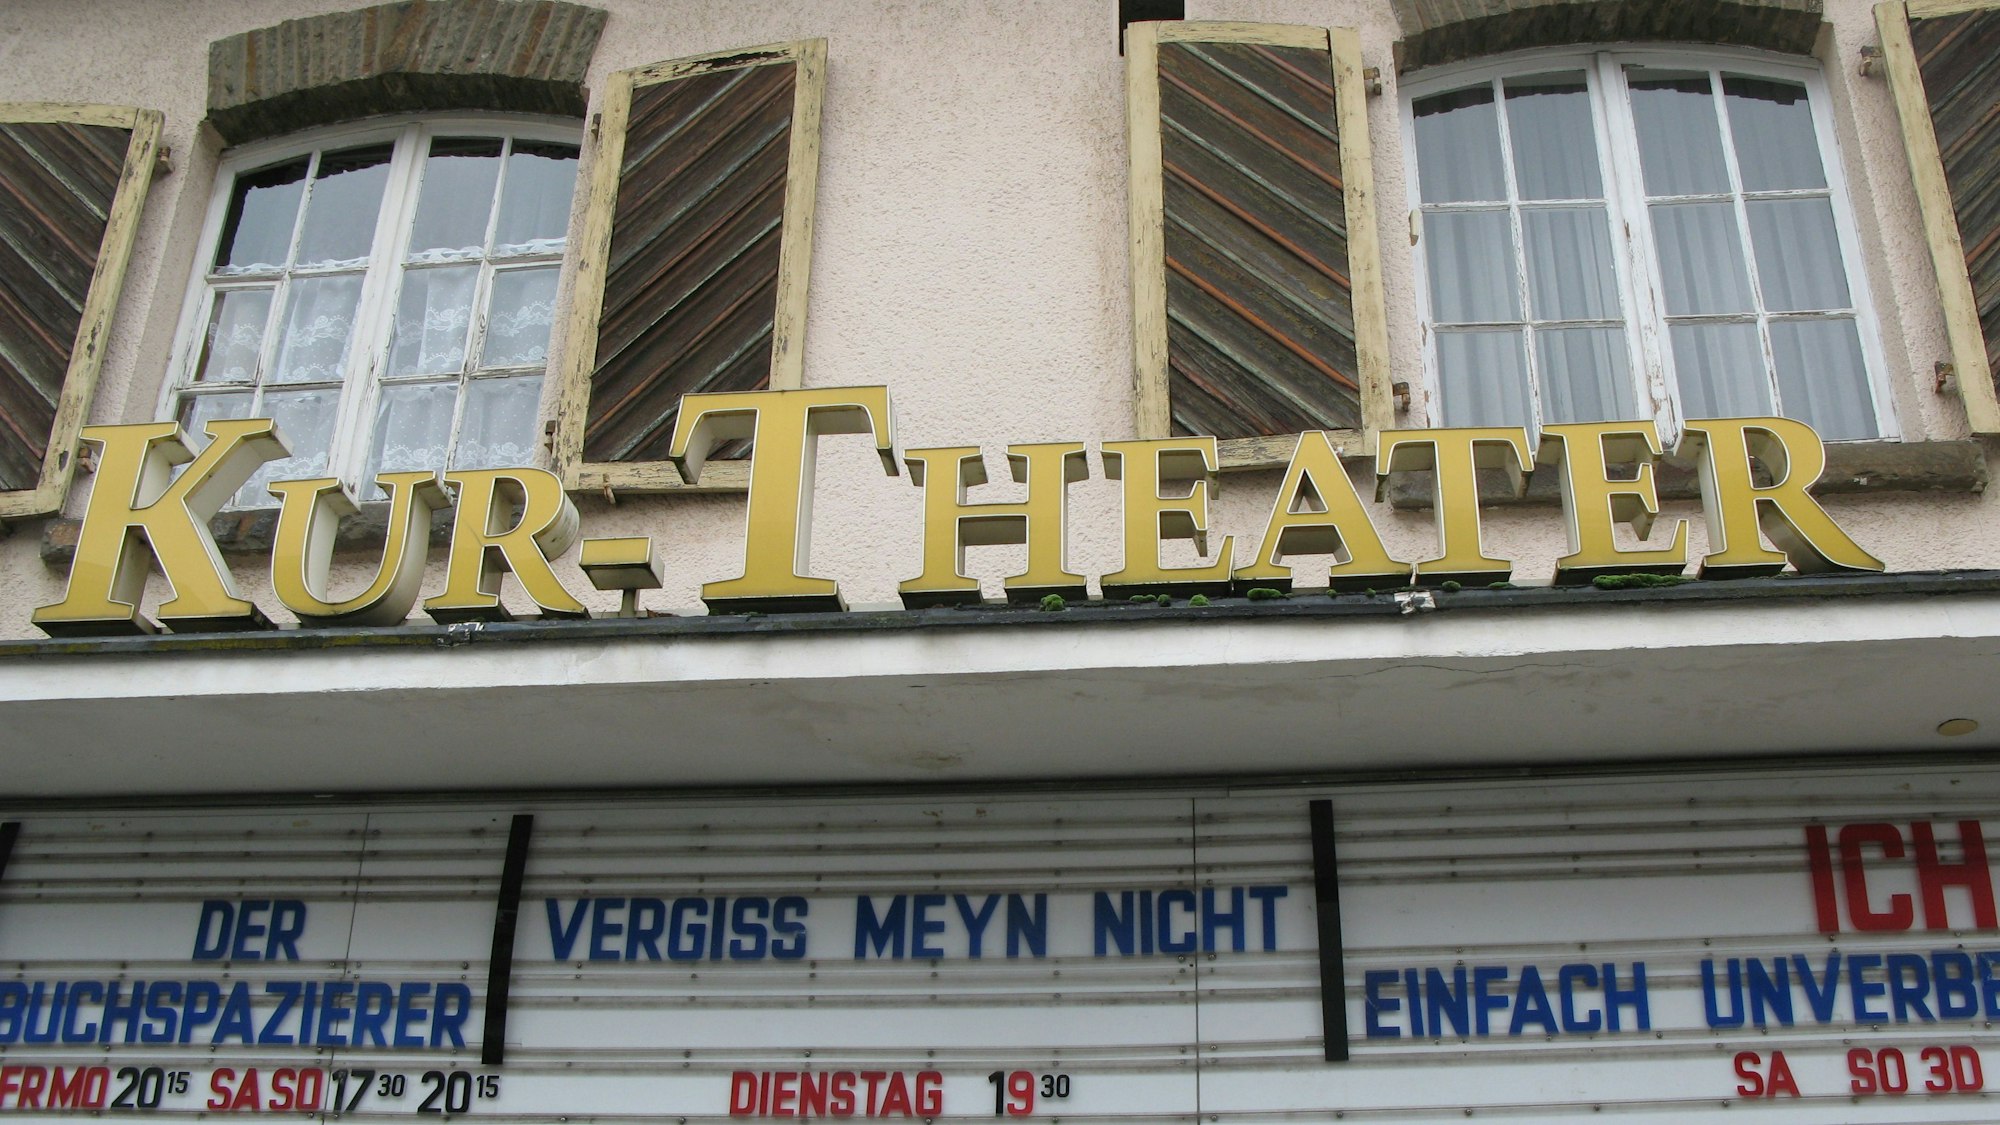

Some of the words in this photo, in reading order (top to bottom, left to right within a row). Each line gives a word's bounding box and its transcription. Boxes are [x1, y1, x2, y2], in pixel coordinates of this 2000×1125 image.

[1805, 820, 1998, 933] ICH
[193, 900, 307, 960] DER
[546, 896, 808, 961] VERGISS
[854, 893, 1047, 960] MEYN
[1094, 885, 1288, 957] NICHT
[0, 981, 471, 1047] BUCHSPAZIERER
[1365, 962, 1650, 1037] EINFACH
[729, 1070, 943, 1118] DIENSTAG
[1733, 1051, 1801, 1099] SA
[1847, 1047, 1909, 1096] SO
[1920, 1045, 1984, 1093] 3D
